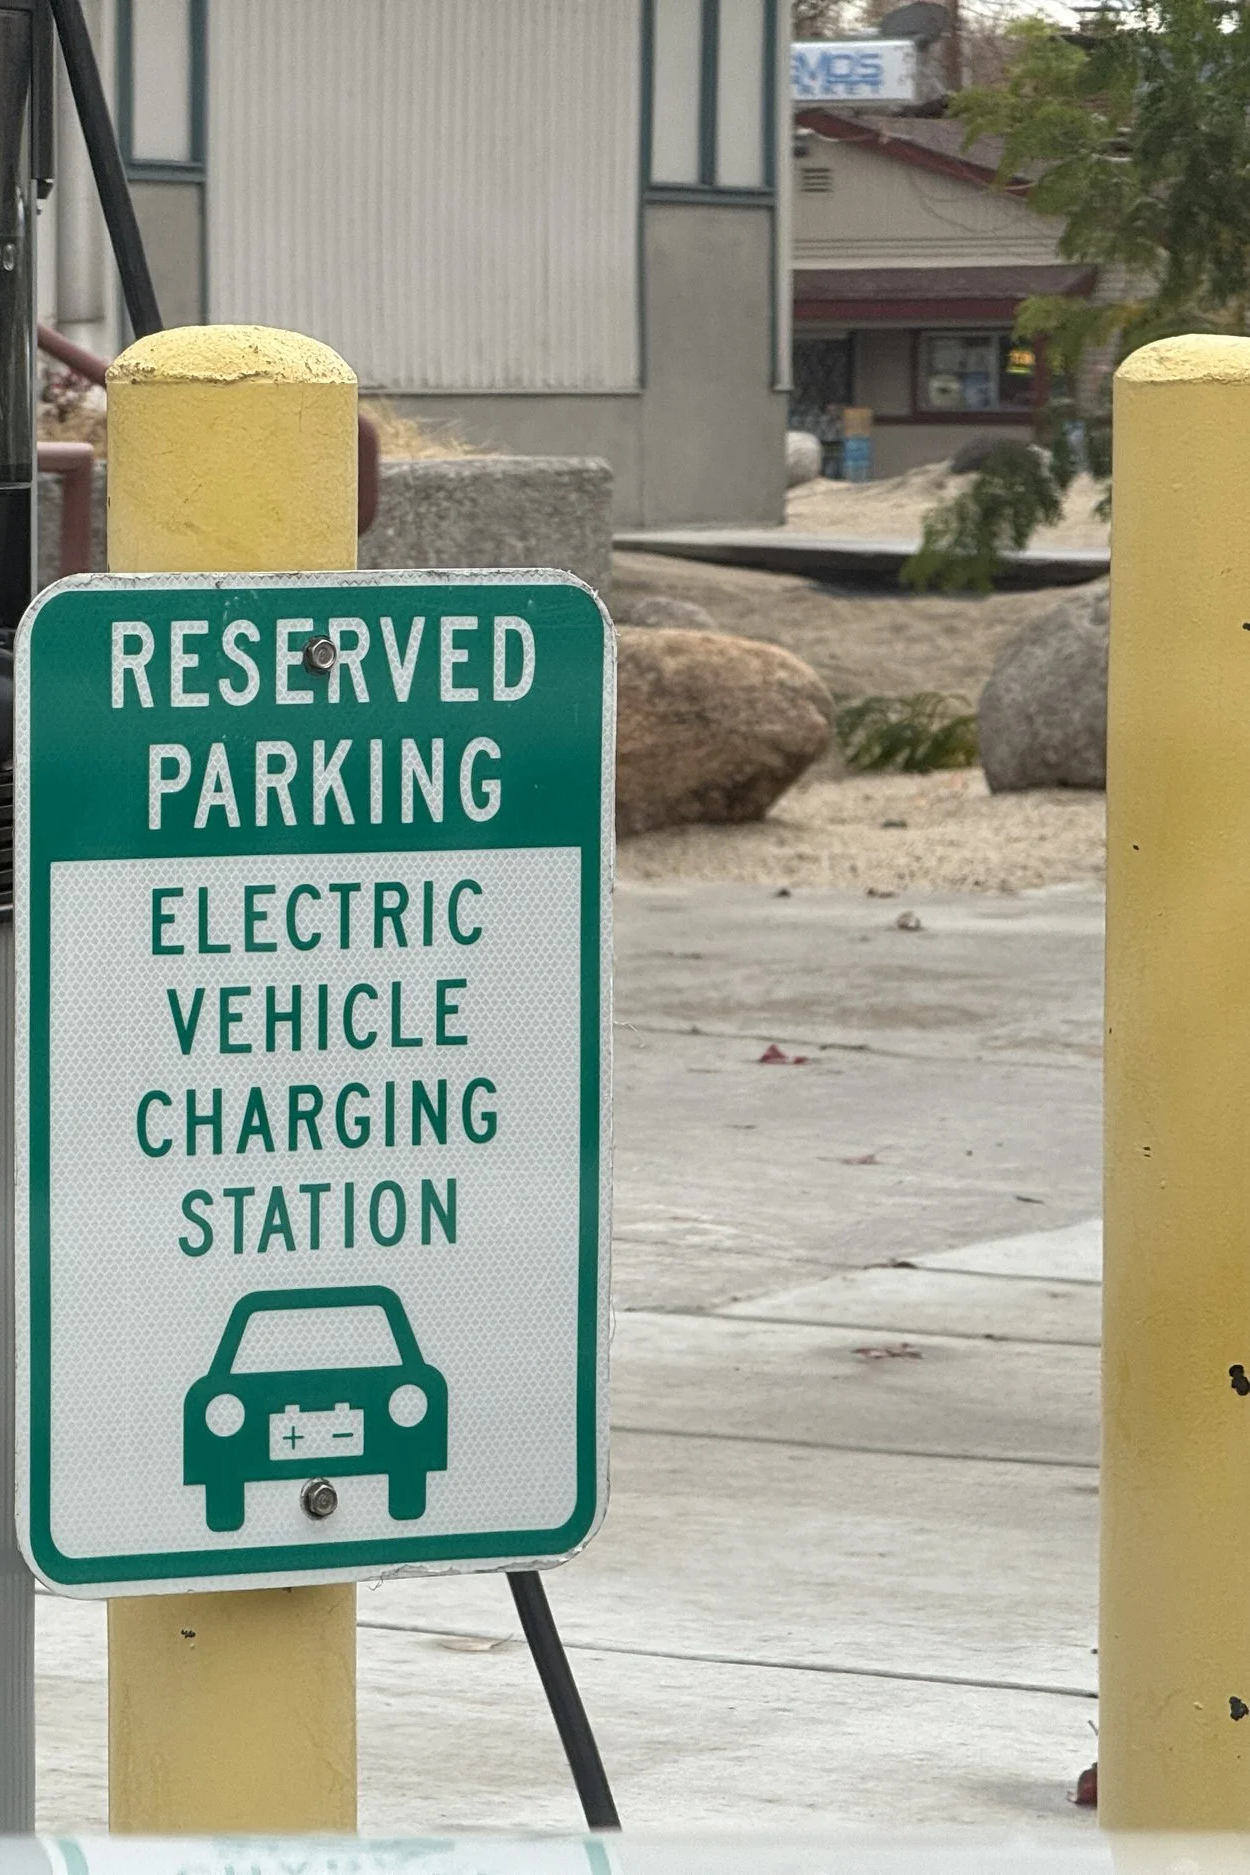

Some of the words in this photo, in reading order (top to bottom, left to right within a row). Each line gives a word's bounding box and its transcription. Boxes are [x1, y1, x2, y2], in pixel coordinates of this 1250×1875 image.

[111, 615, 536, 709] RESERVED
[149, 736, 502, 830] PARKING
[151, 879, 483, 956] ELECTRIC
[166, 978, 468, 1055] VEHICLE
[136, 1077, 498, 1158] CHARGING
[178, 1178, 457, 1257] STATION
